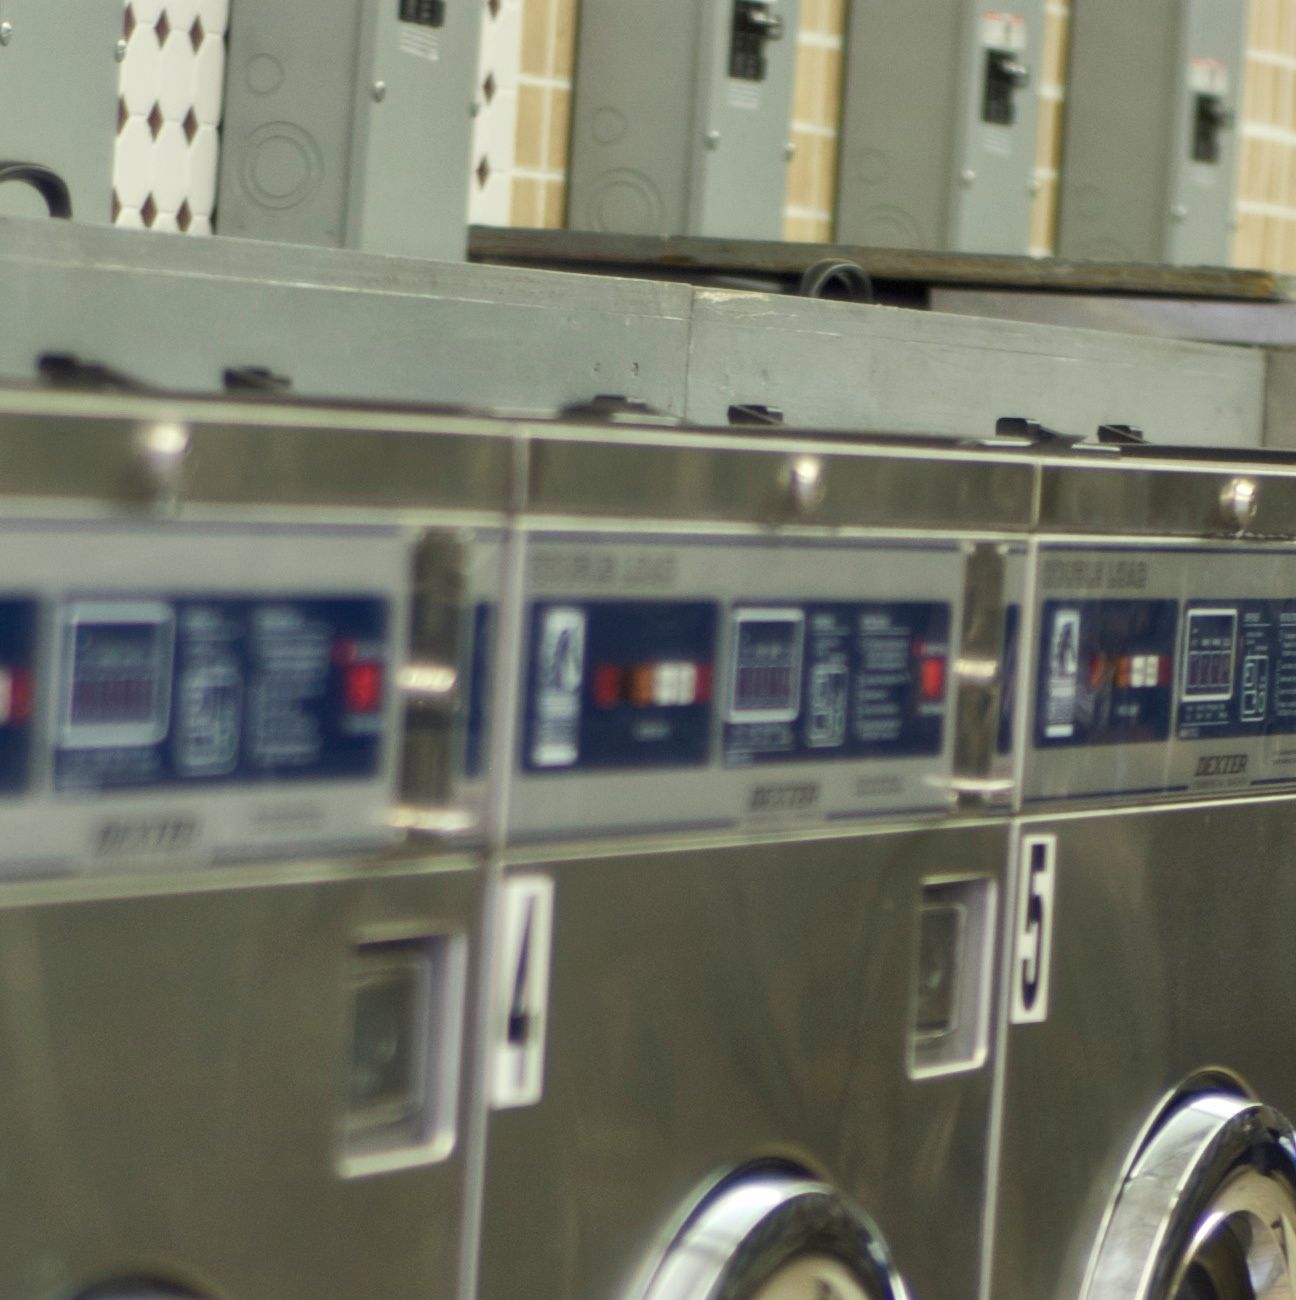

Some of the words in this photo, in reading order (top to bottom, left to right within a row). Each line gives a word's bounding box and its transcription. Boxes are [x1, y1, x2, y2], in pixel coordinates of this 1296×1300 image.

[1195, 755, 1248, 776] DEXTER
[504, 893, 538, 1090] 4
[1021, 842, 1048, 1011] 5
